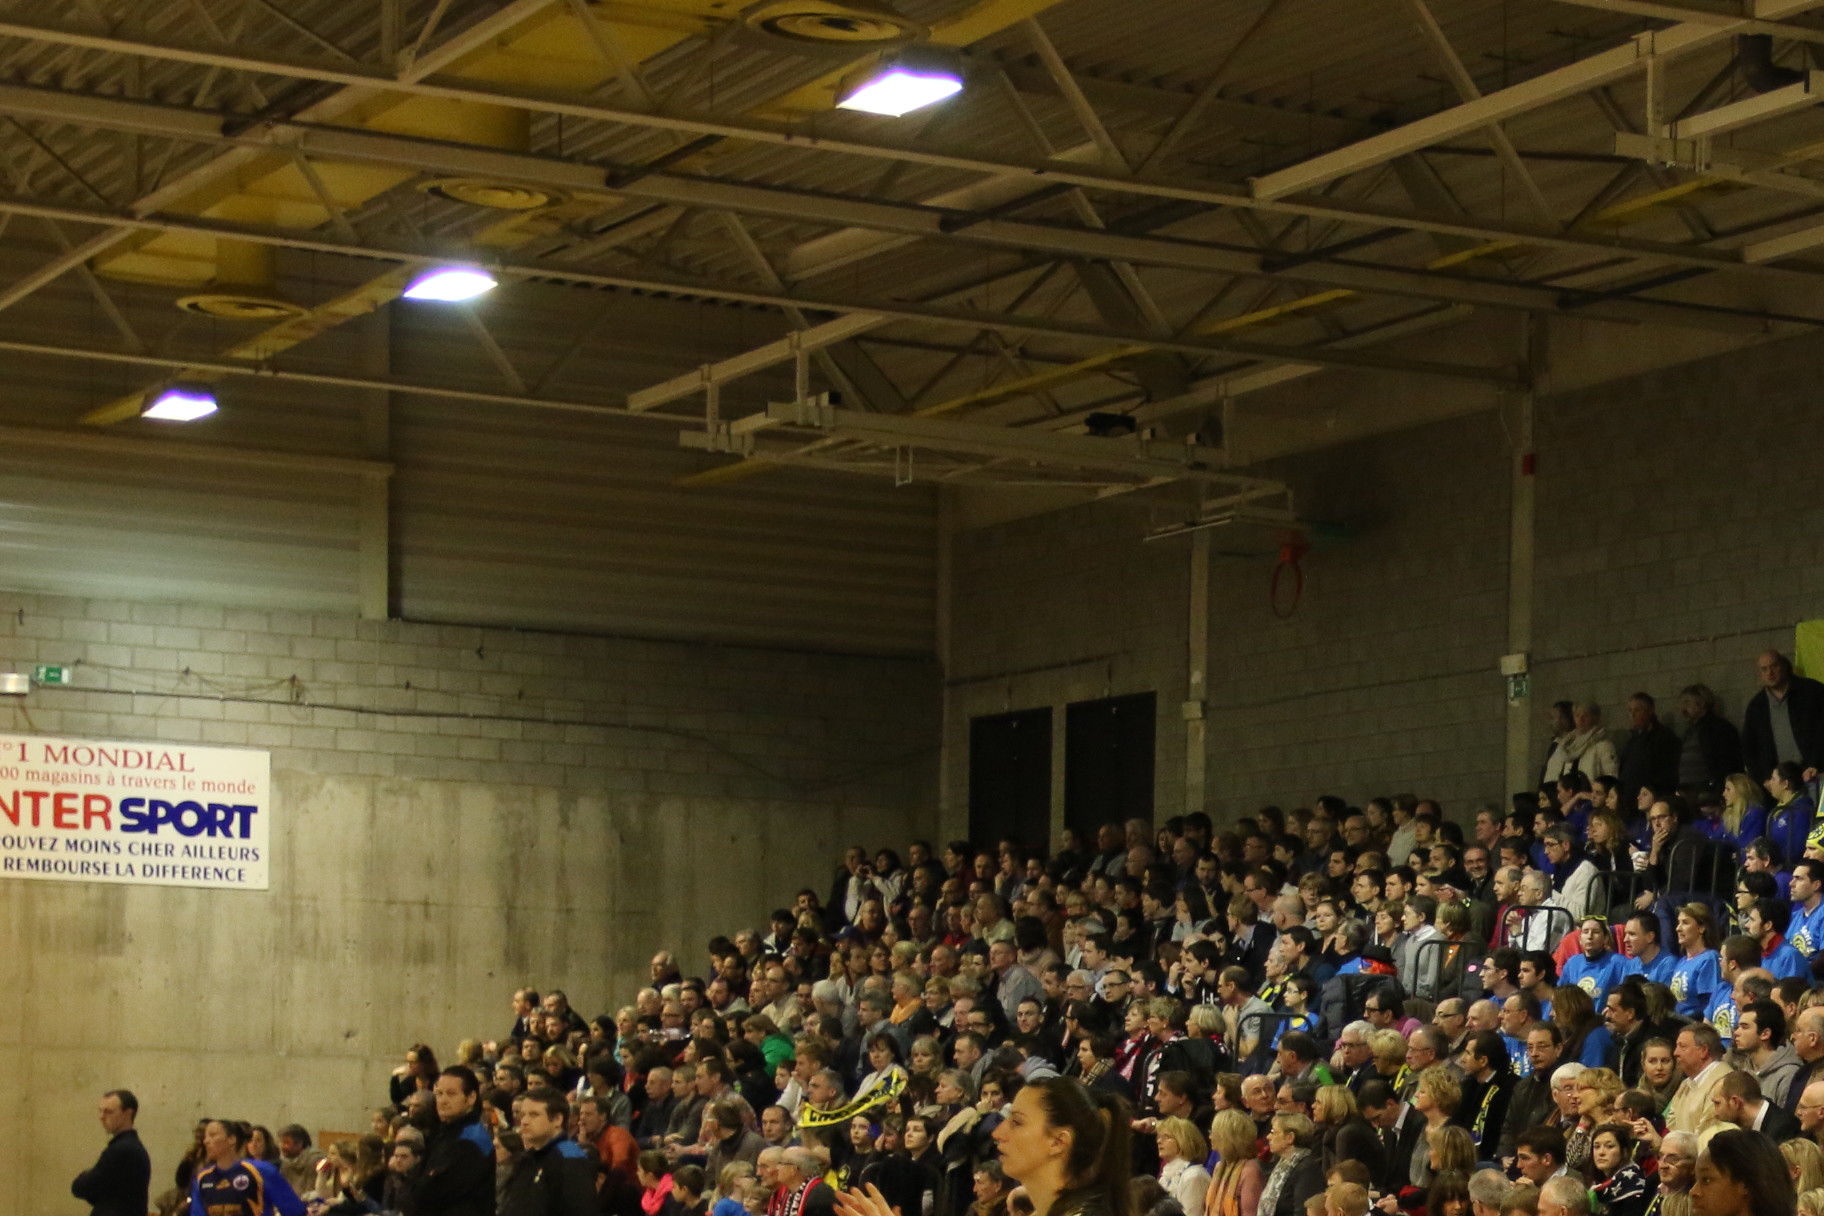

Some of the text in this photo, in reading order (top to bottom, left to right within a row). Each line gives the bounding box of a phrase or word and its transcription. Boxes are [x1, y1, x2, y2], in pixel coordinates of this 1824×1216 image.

[44, 744, 195, 773] MONDIAL
[0, 767, 256, 794] 00 magasins à travers le monde
[0, 790, 112, 831] NTER
[1, 835, 260, 862] OUVEZ MOINS CHER AILLEURS
[4, 856, 246, 882] REMBOURSE LA DIFFERENCE
